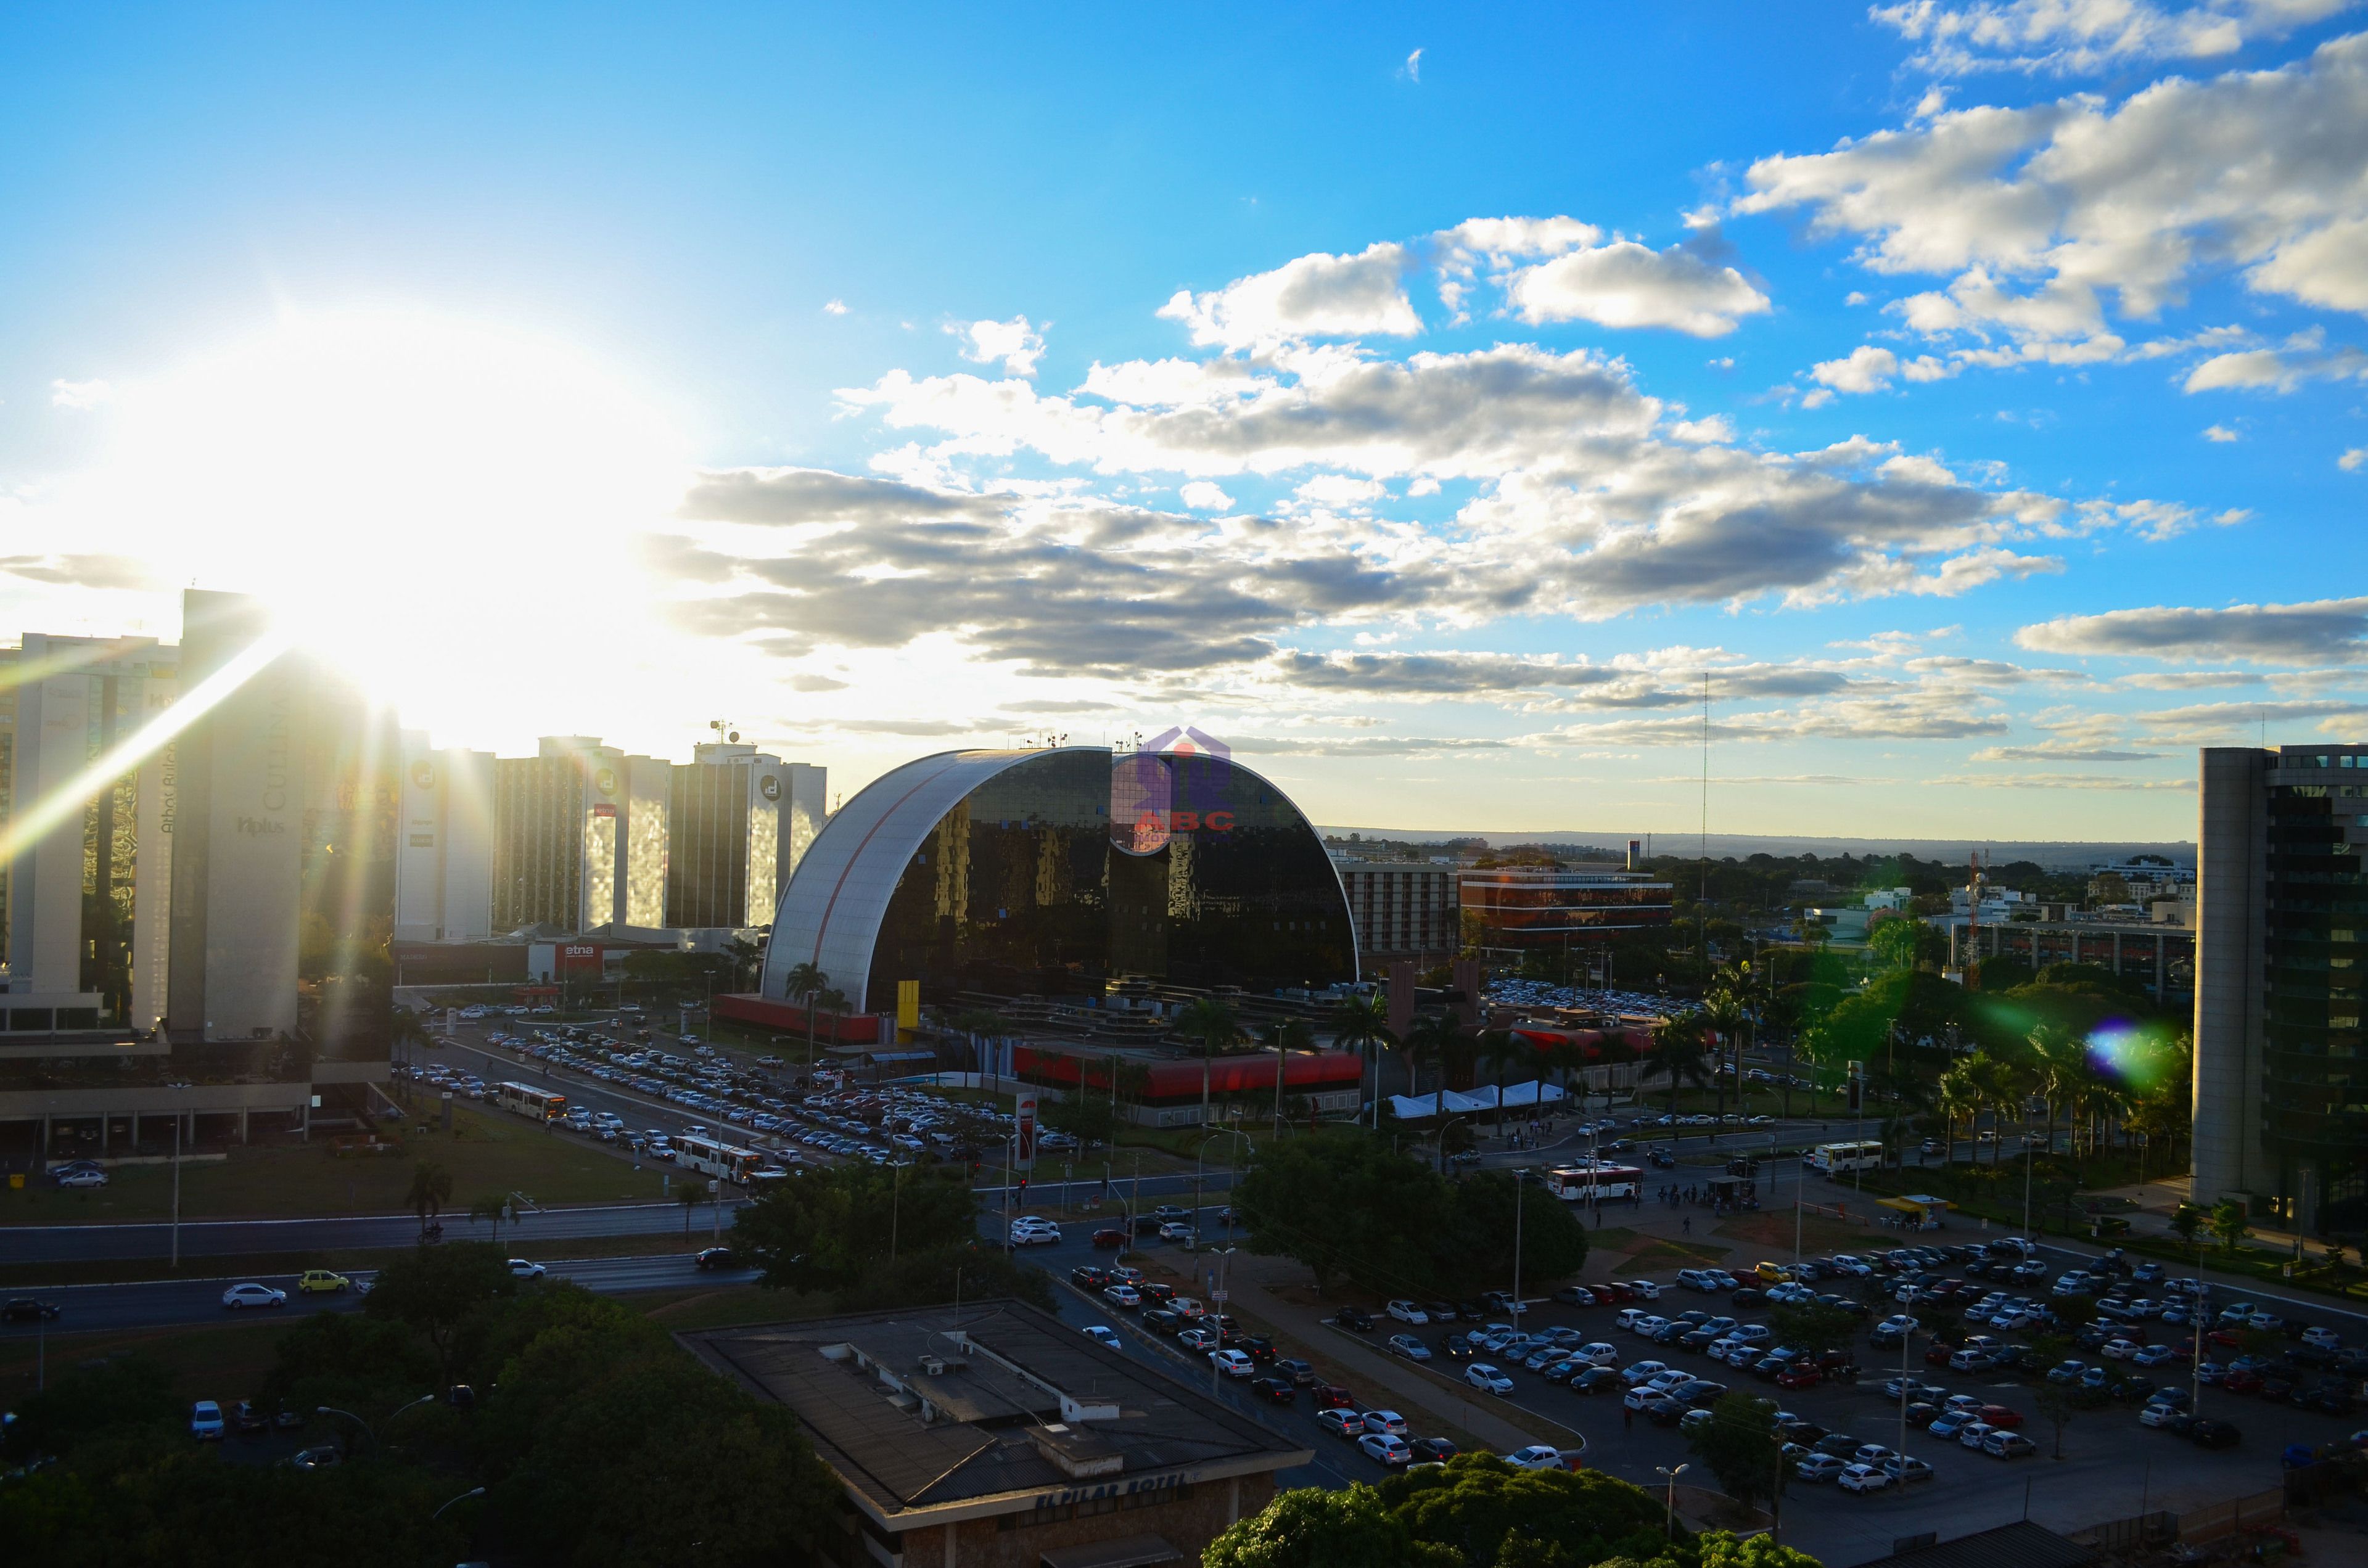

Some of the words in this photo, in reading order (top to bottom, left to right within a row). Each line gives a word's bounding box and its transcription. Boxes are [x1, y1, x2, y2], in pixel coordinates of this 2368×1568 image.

[566, 945, 593, 954] etna
[1035, 1495, 1056, 1510] EL
[1059, 1484, 1119, 1506] PILAR
[1127, 1473, 1187, 1495] HOTEL
